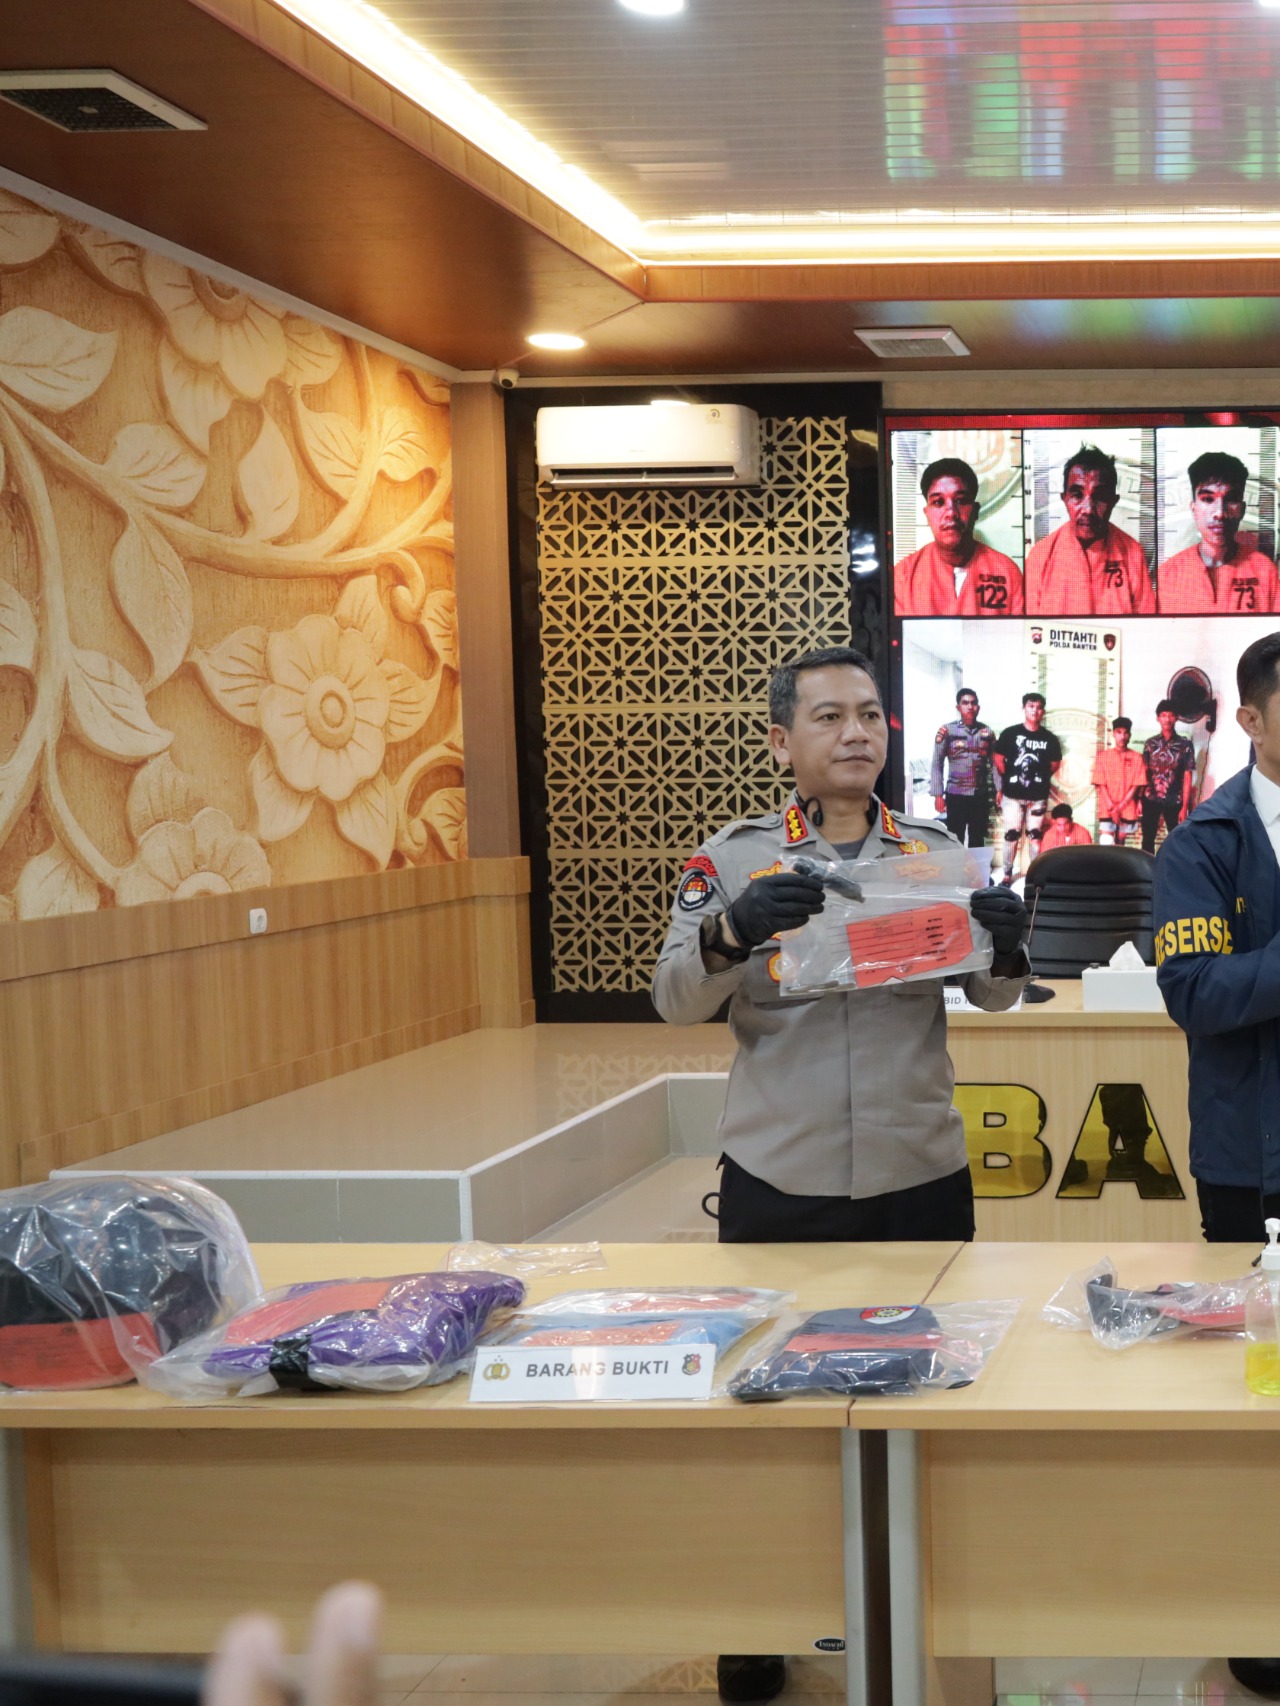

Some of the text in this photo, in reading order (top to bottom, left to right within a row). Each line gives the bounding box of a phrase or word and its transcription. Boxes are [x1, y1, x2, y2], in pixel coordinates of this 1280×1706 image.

[975, 584, 1008, 609] 122
[1234, 586, 1255, 610] 73
[1049, 629, 1097, 643] DITTAHTI
[1049, 641, 1097, 651] POLDA BANTEN
[526, 1360, 669, 1378] BARANG BUKTI
